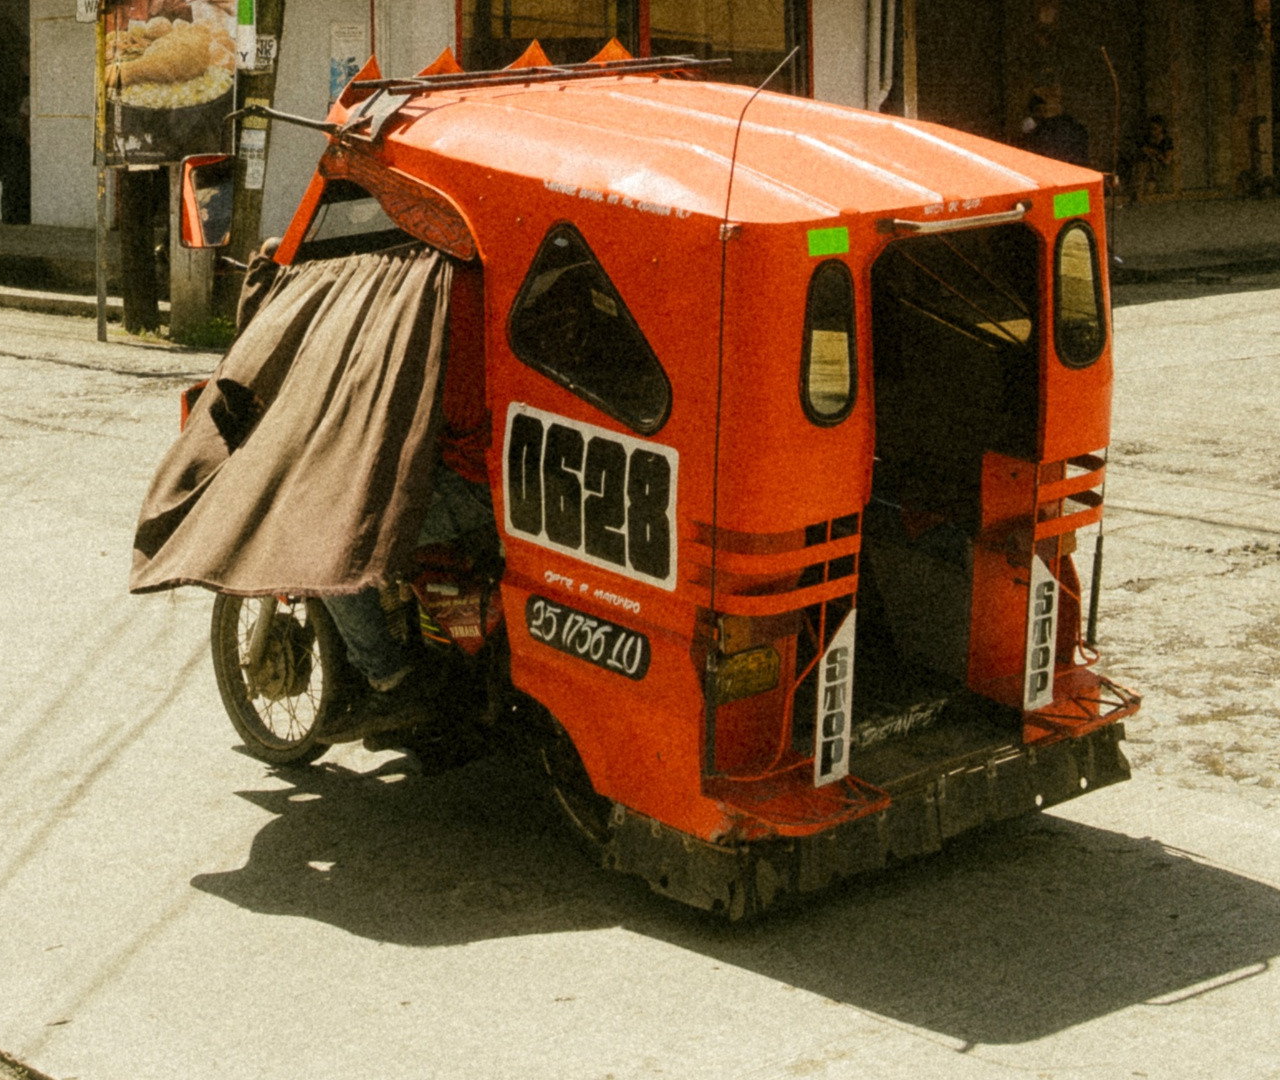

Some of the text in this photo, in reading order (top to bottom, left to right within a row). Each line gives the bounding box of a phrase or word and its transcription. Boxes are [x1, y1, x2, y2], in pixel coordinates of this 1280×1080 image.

[507, 413, 671, 581] 0628
[1028, 580, 1056, 704] STOP
[820, 646, 849, 778] STOP
